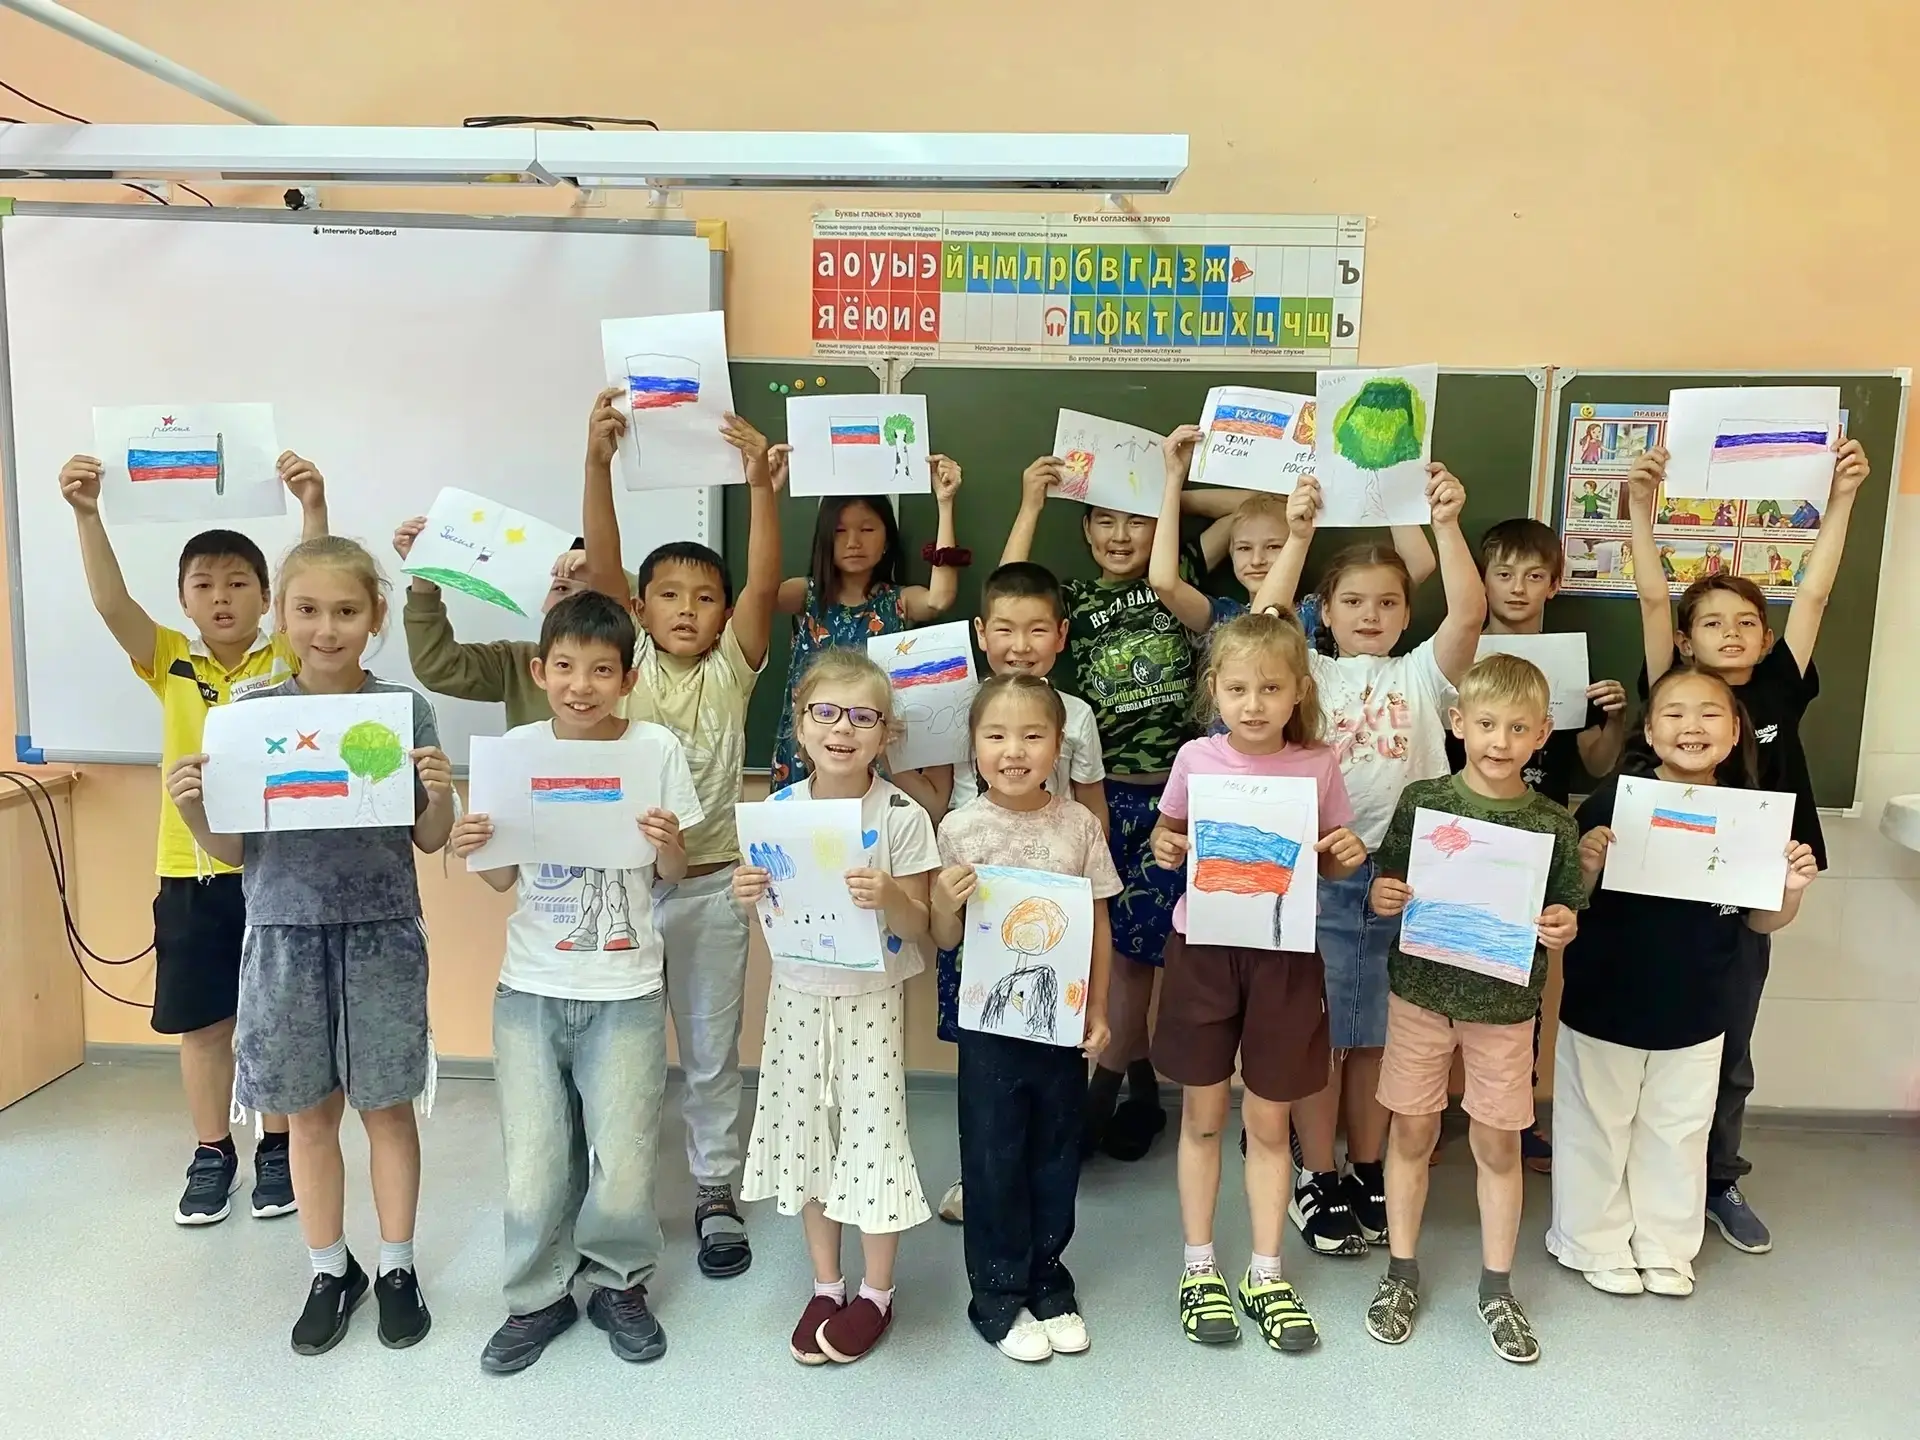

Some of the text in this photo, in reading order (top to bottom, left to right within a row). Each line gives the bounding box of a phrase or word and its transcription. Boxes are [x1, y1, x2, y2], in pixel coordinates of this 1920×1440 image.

[834, 210, 922, 220] Буквы гласных звуков
[1072, 214, 1170, 223] Буквы согласных звуков
[322, 226, 397, 236] Interwrite DualBoard
[974, 344, 1006, 352] Непарные
[1108, 346, 1133, 354] Парные
[1250, 348, 1282, 356] Непарные
[1089, 610, 1110, 629] НЕ
[552, 914, 577, 924] 2073
